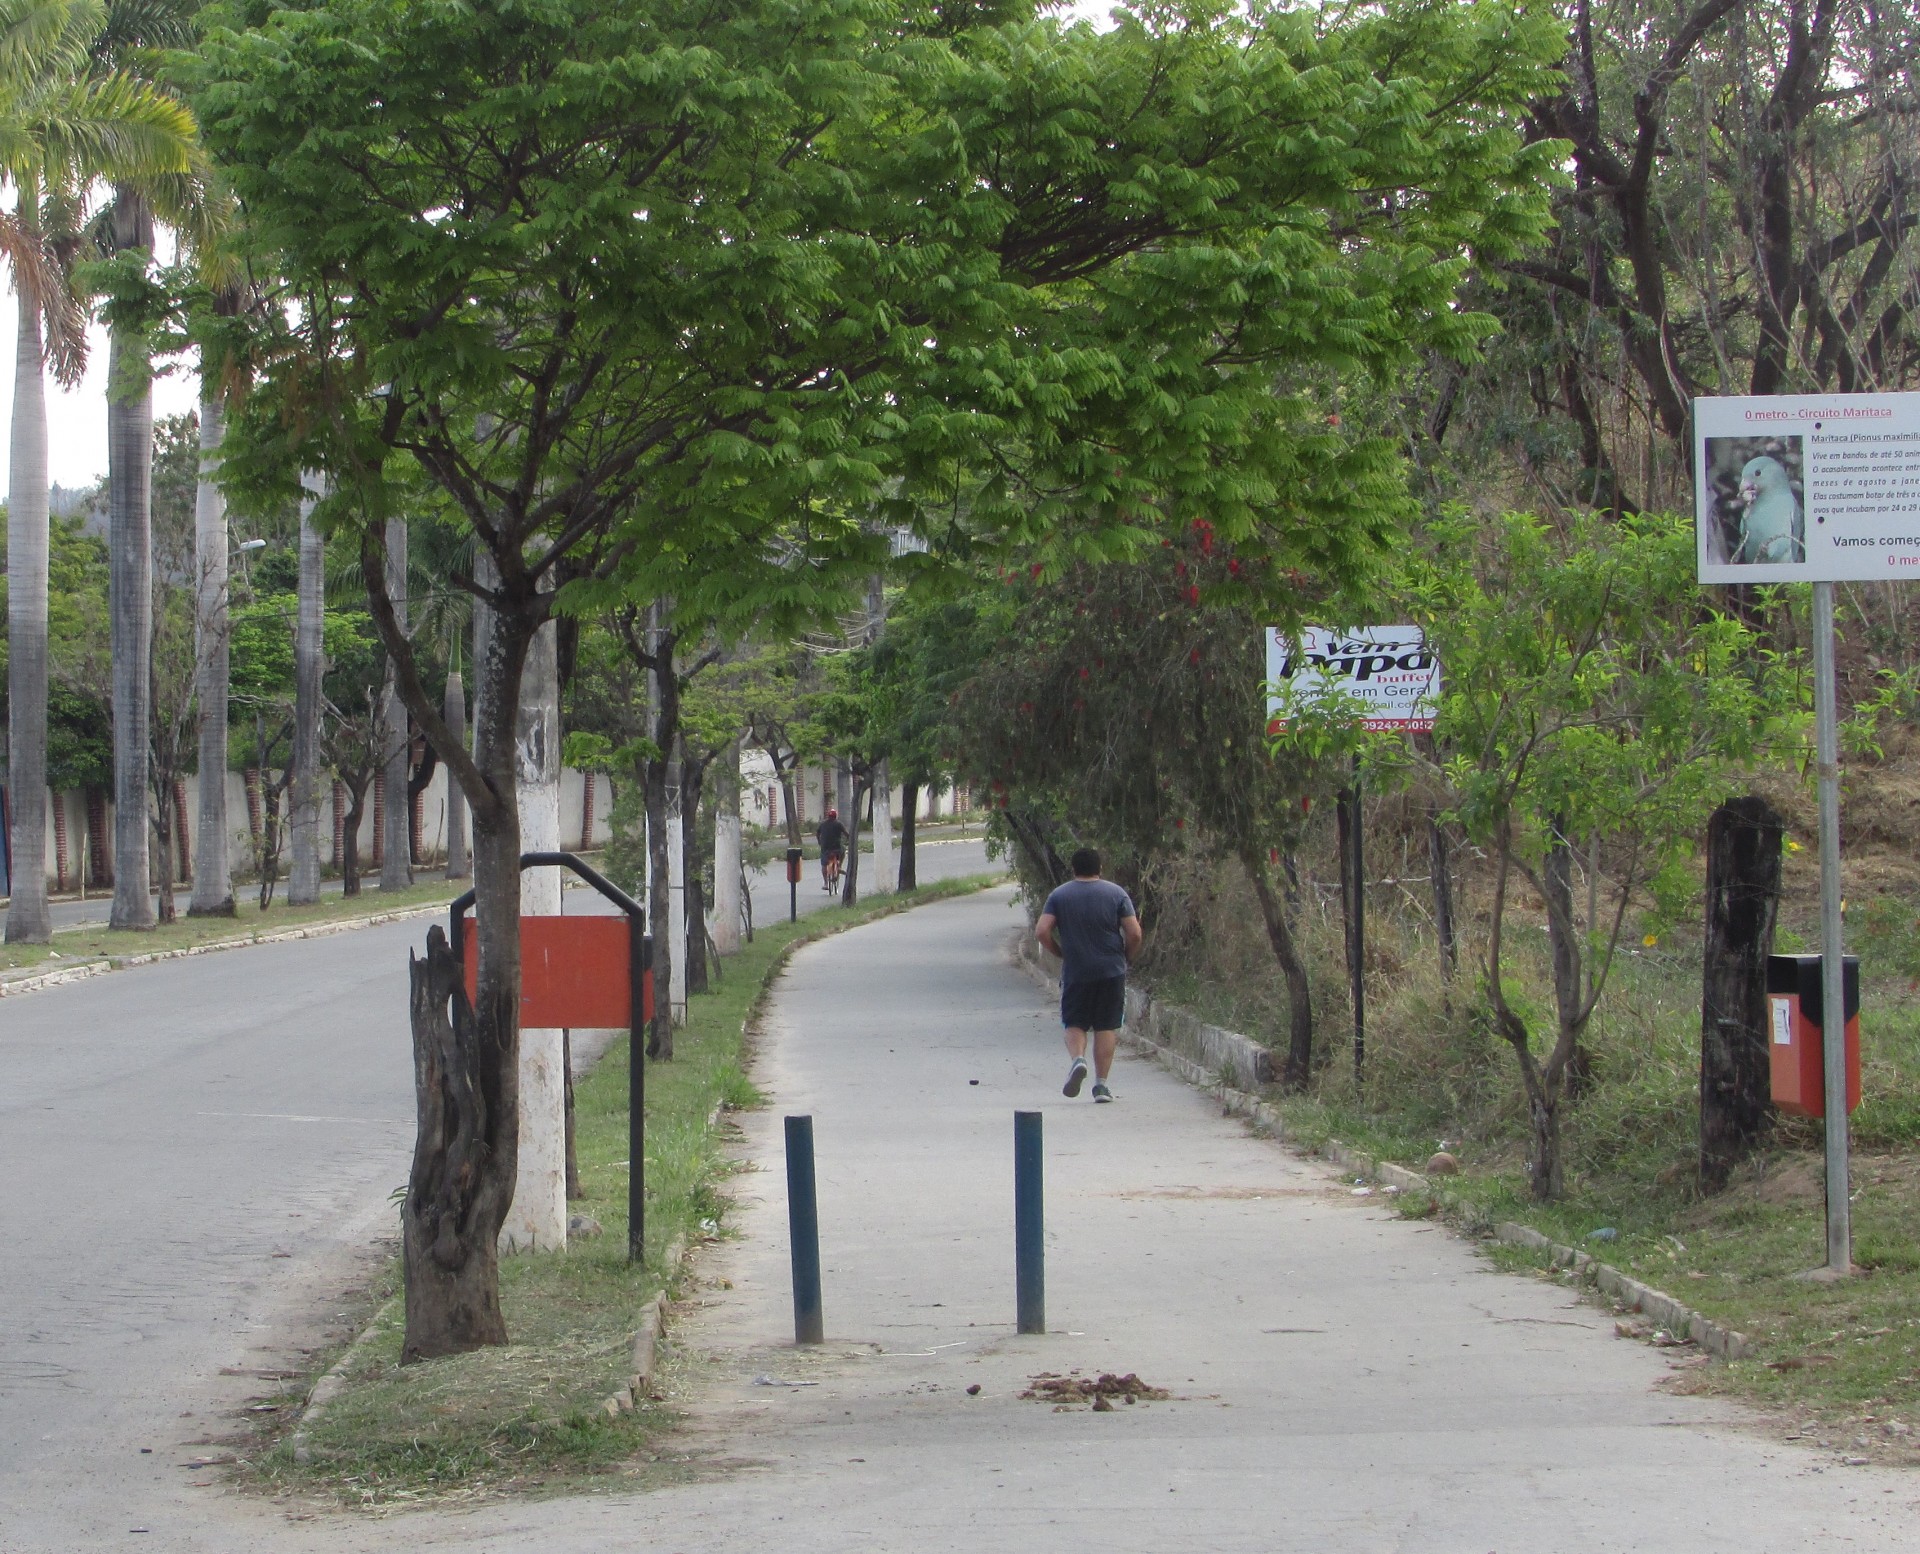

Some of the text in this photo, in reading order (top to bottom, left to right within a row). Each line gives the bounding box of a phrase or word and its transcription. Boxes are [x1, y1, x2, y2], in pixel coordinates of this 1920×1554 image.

[1745, 410, 1751, 419] 0
[1755, 410, 1788, 420] metro
[1798, 409, 1840, 418] Circuito
[1843, 407, 1892, 417] Maritaca
[1811, 434, 1848, 442] Maritaca
[1850, 433, 1882, 442] (Pionus
[1812, 452, 1827, 460] Vive
[1842, 451, 1868, 459] bandos
[1869, 451, 1879, 459] de
[1880, 450, 1892, 458] até
[1893, 450, 1903, 458] 50
[1812, 465, 1819, 473] O
[1821, 465, 1869, 473] acasalamento
[1843, 478, 1853, 486] de
[1857, 479, 1887, 487] agosto
[1865, 491, 1884, 499] botar
[1896, 490, 1910, 498] três
[1831, 507, 1845, 515] que
[1845, 505, 1876, 513] incubam
[1877, 506, 1889, 514] por
[1908, 503, 1917, 511] 29
[1832, 536, 1875, 547] Vamos
[1888, 555, 1920, 566] 0 me
[1325, 641, 1399, 656] Vem
[1377, 673, 1431, 683] buffet
[1351, 686, 1378, 697] em
[1384, 684, 1430, 696] Geral
